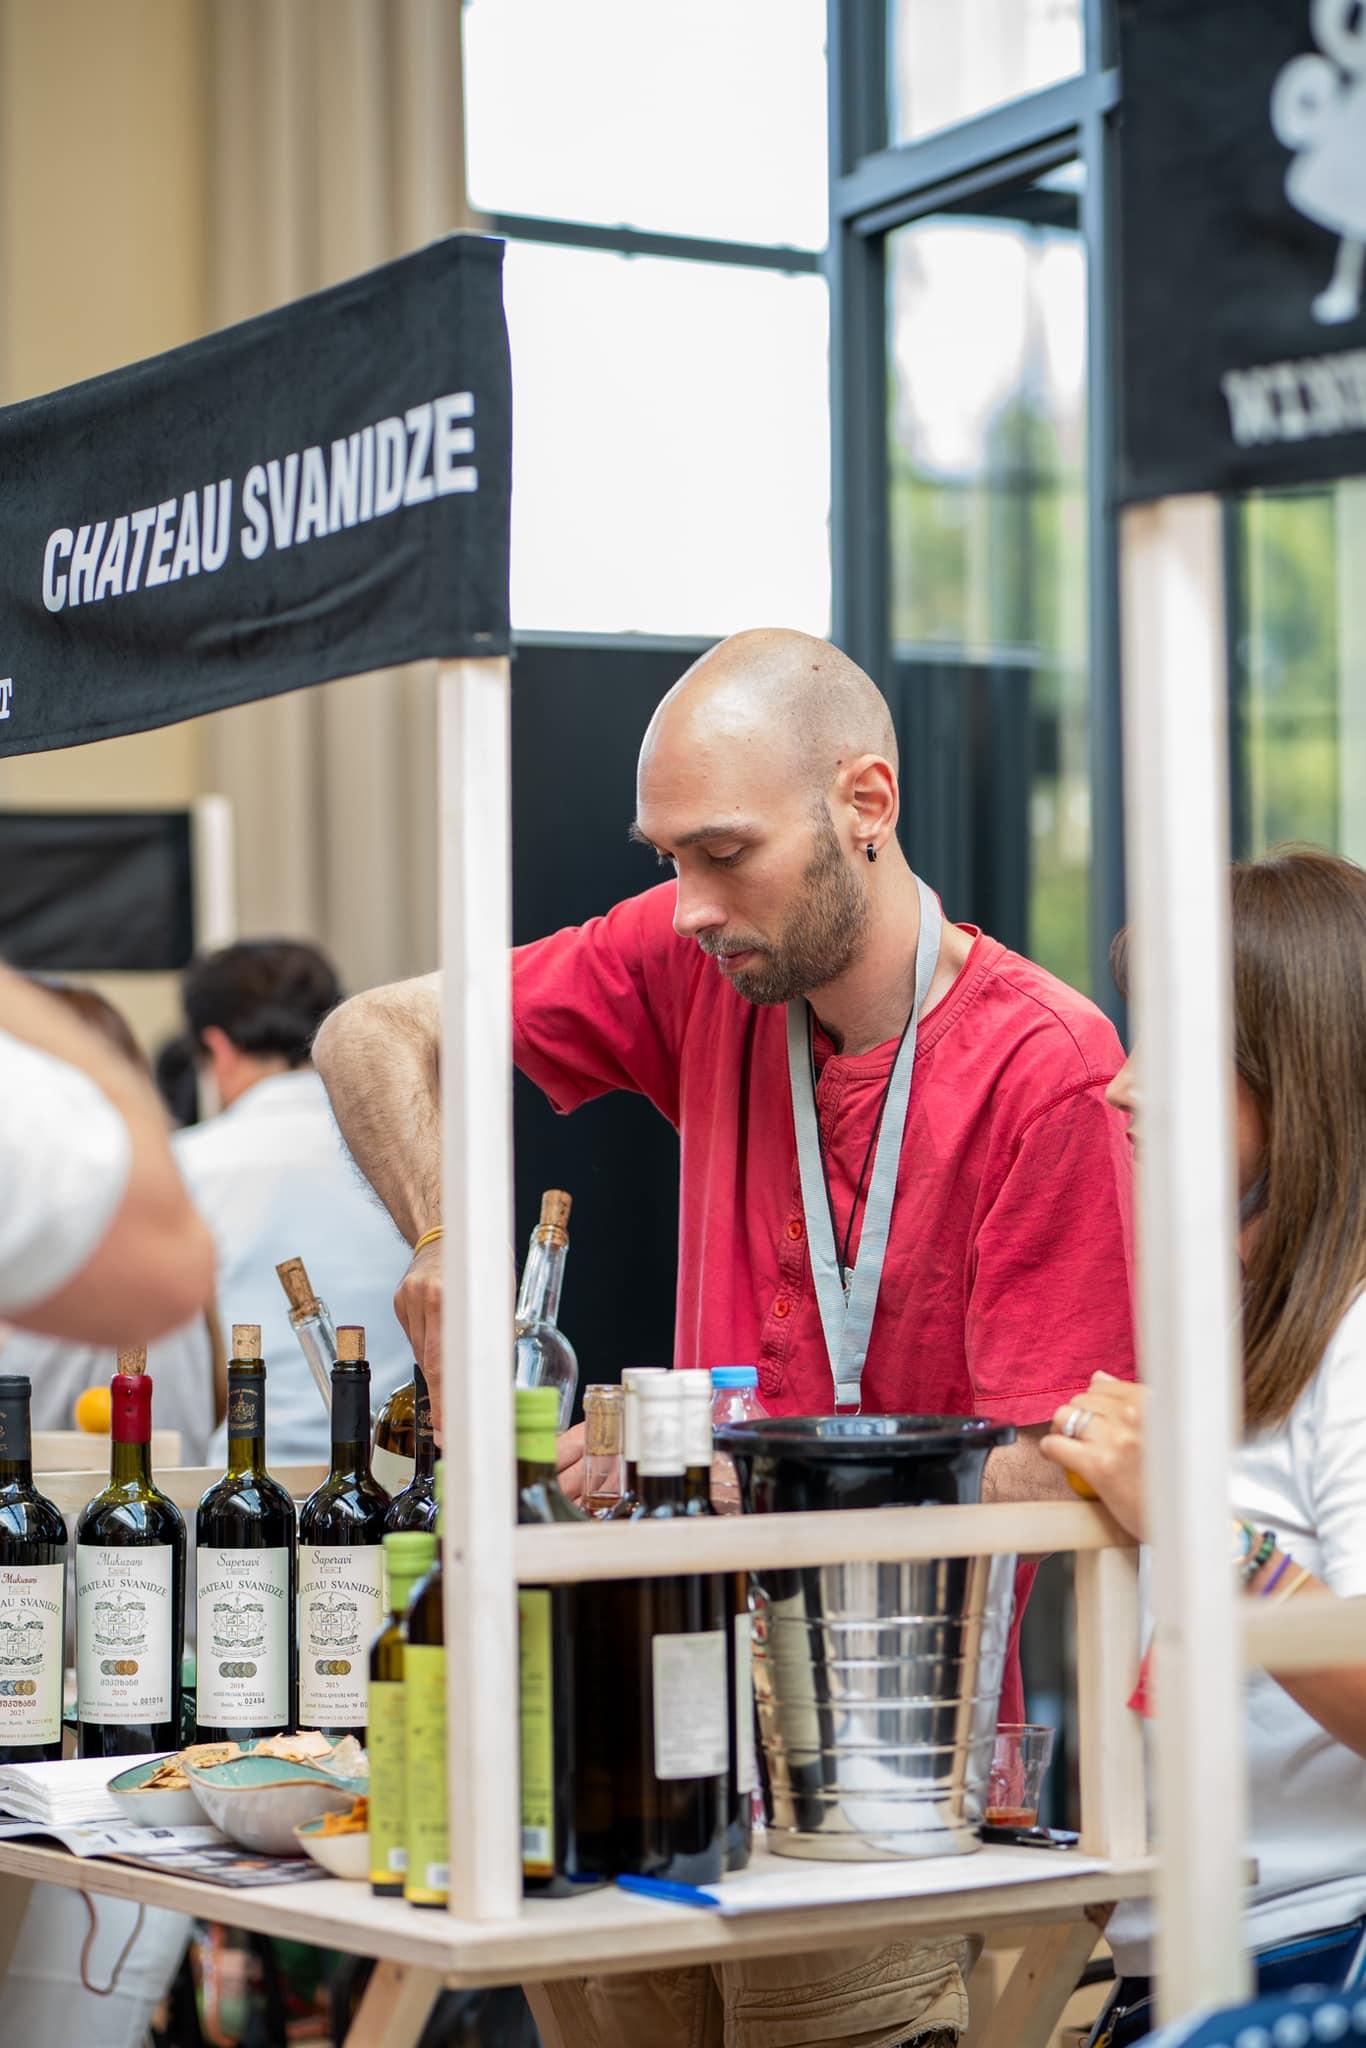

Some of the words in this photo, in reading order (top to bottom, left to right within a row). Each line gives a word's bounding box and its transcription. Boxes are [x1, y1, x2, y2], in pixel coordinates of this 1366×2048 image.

[42, 478, 232, 613] CHATEAU
[240, 391, 478, 561] SVANIDZE
[217, 1552, 260, 1568] Saperavi
[312, 1550, 352, 1567] Saperavi
[79, 1579, 115, 1598] CHATEAU
[120, 1579, 168, 1598] SVANIDZE
[239, 1580, 285, 1599] SVANIDZE
[331, 1581, 381, 1599] SVANIDZE
